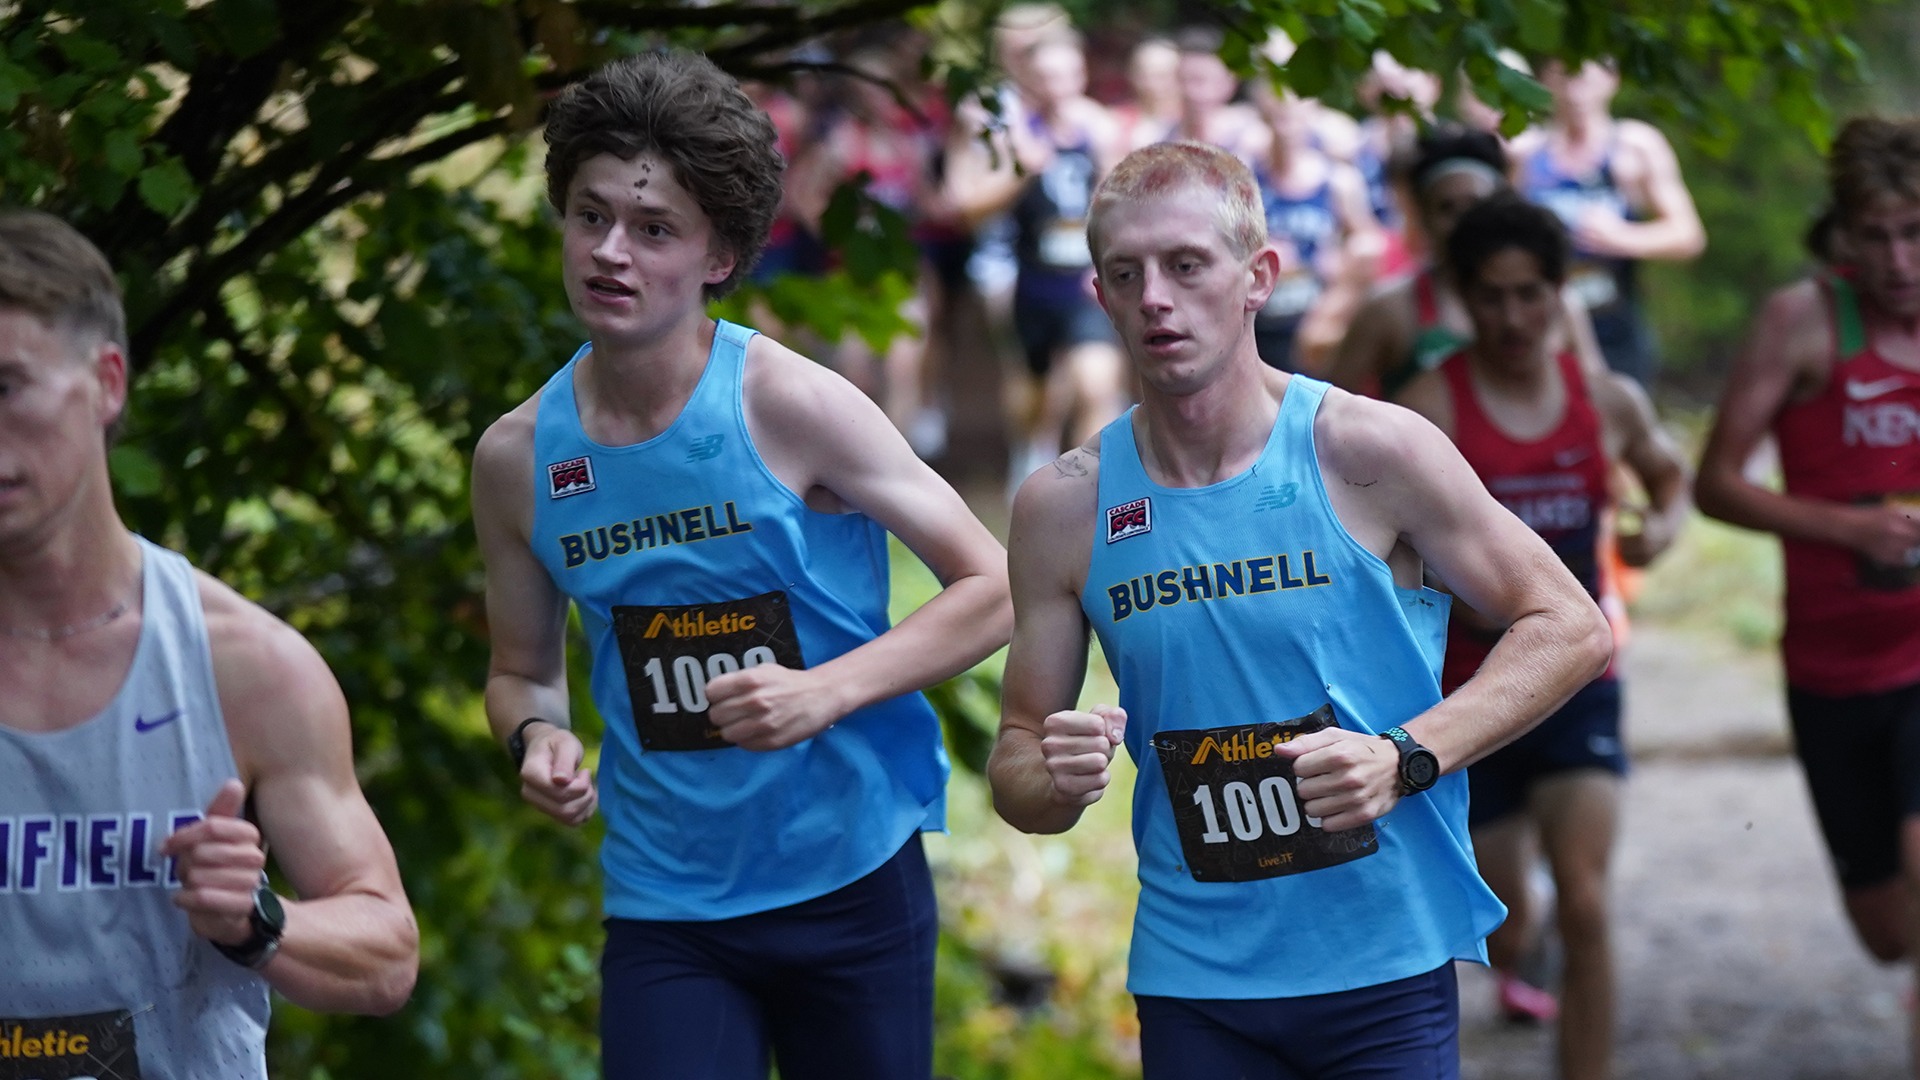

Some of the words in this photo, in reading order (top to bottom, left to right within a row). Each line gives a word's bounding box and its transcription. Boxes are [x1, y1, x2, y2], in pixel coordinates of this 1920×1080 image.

[550, 458, 587, 472] CASCADE
[554, 468, 588, 488] CCC
[1109, 499, 1146, 516] CASCADE
[1112, 510, 1146, 530] CCC
[558, 501, 753, 569] BUSHNELL
[1107, 550, 1330, 623] BUSHNELL
[643, 610, 757, 639] Athletic
[1193, 776, 1323, 844] 100
[0, 811, 206, 893] FIEL
